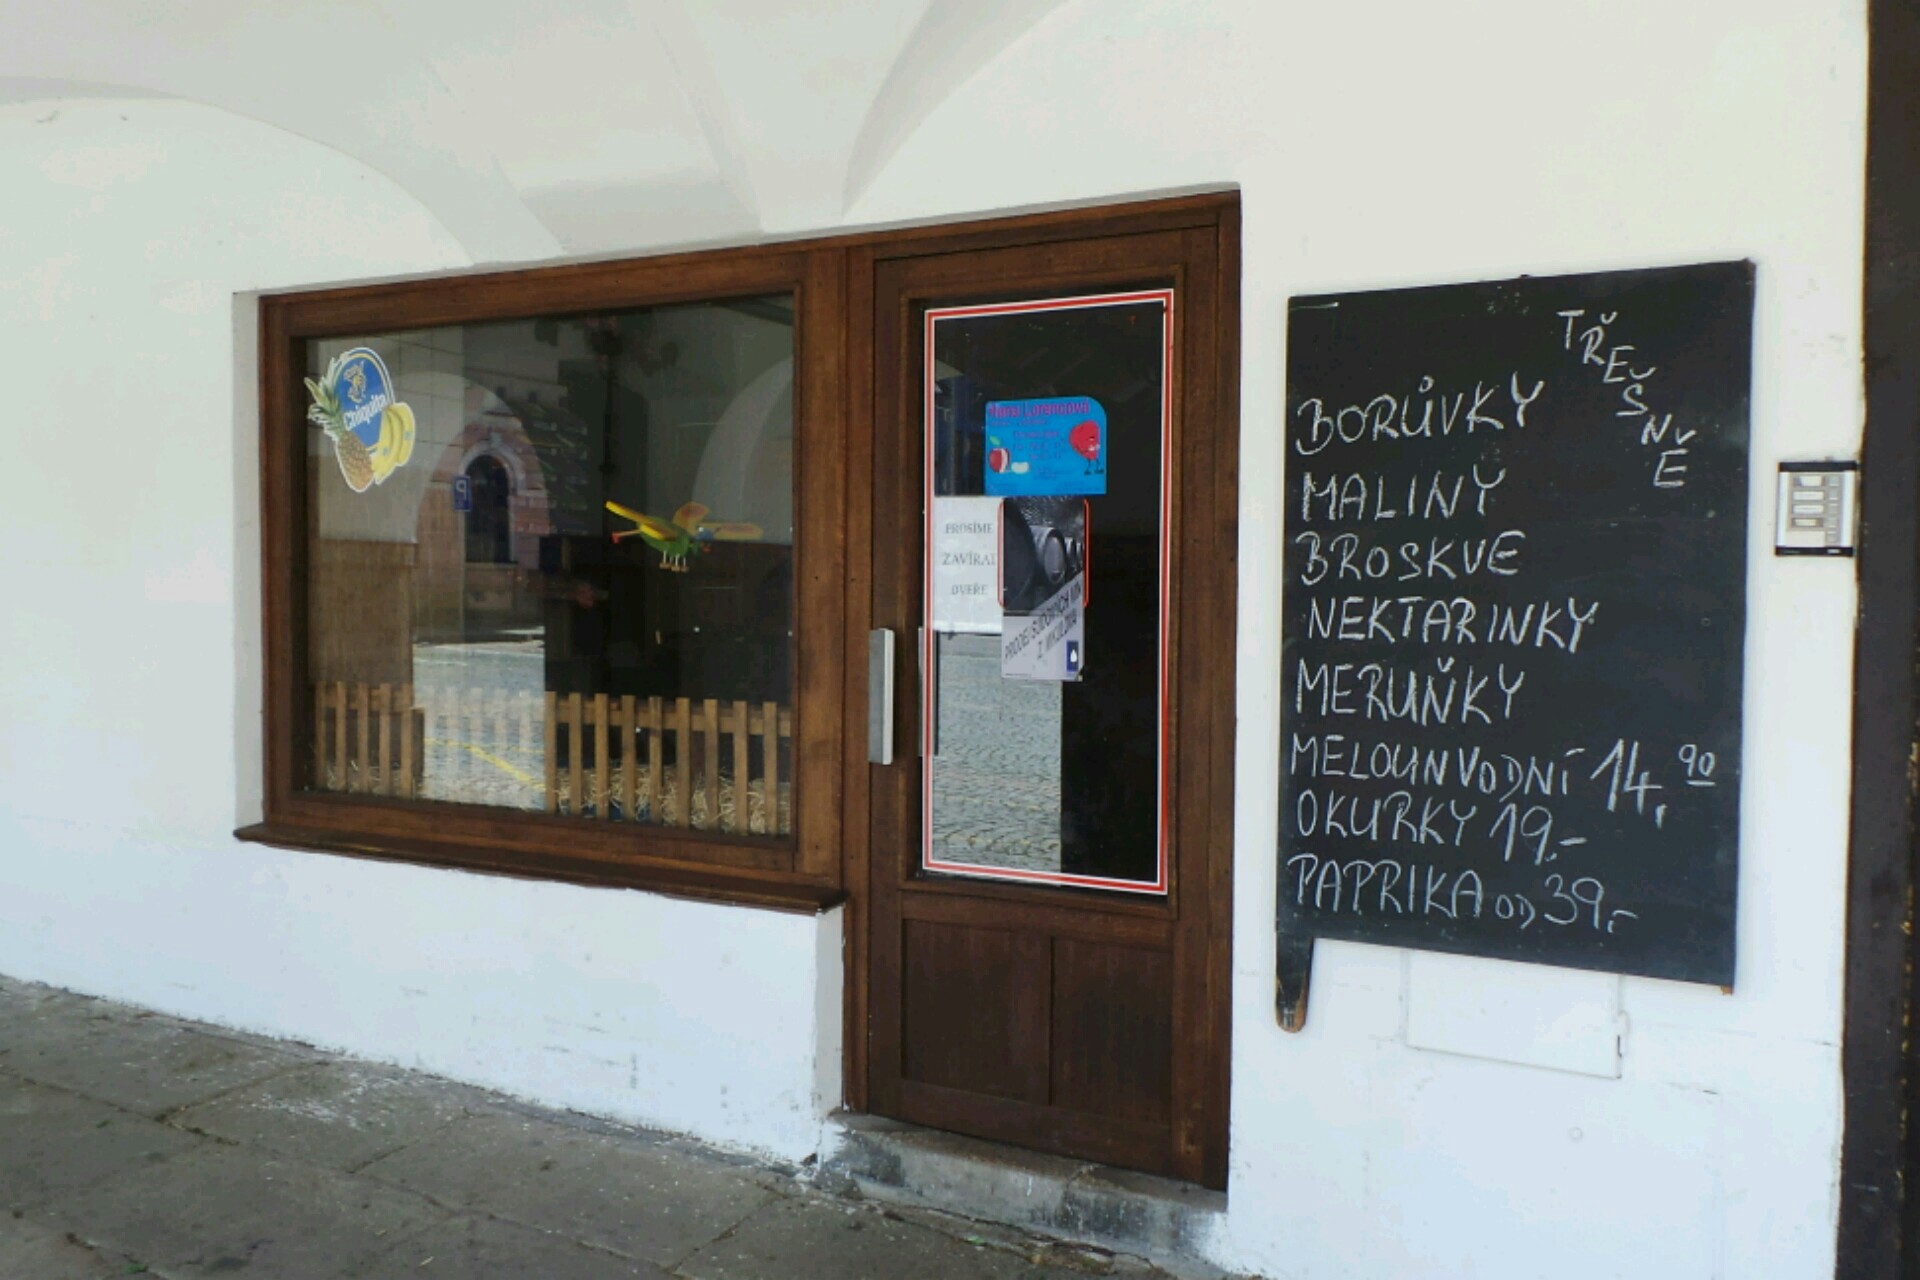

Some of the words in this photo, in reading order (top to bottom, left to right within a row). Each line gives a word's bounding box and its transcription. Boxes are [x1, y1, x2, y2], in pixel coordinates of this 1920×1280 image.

[1296, 373, 1544, 455] BORŮVKY
[1302, 464, 1506, 522] MALINY
[944, 521, 993, 534] PROSÍME
[1296, 530, 1526, 586] BROSKVE
[1308, 596, 1599, 654] NEKTARINKY
[1296, 656, 1525, 726] MERUŇKY
[1297, 789, 1477, 846] OKURKY
[1287, 853, 1483, 918] PAPRIKA
[1496, 894, 1536, 929] OD
